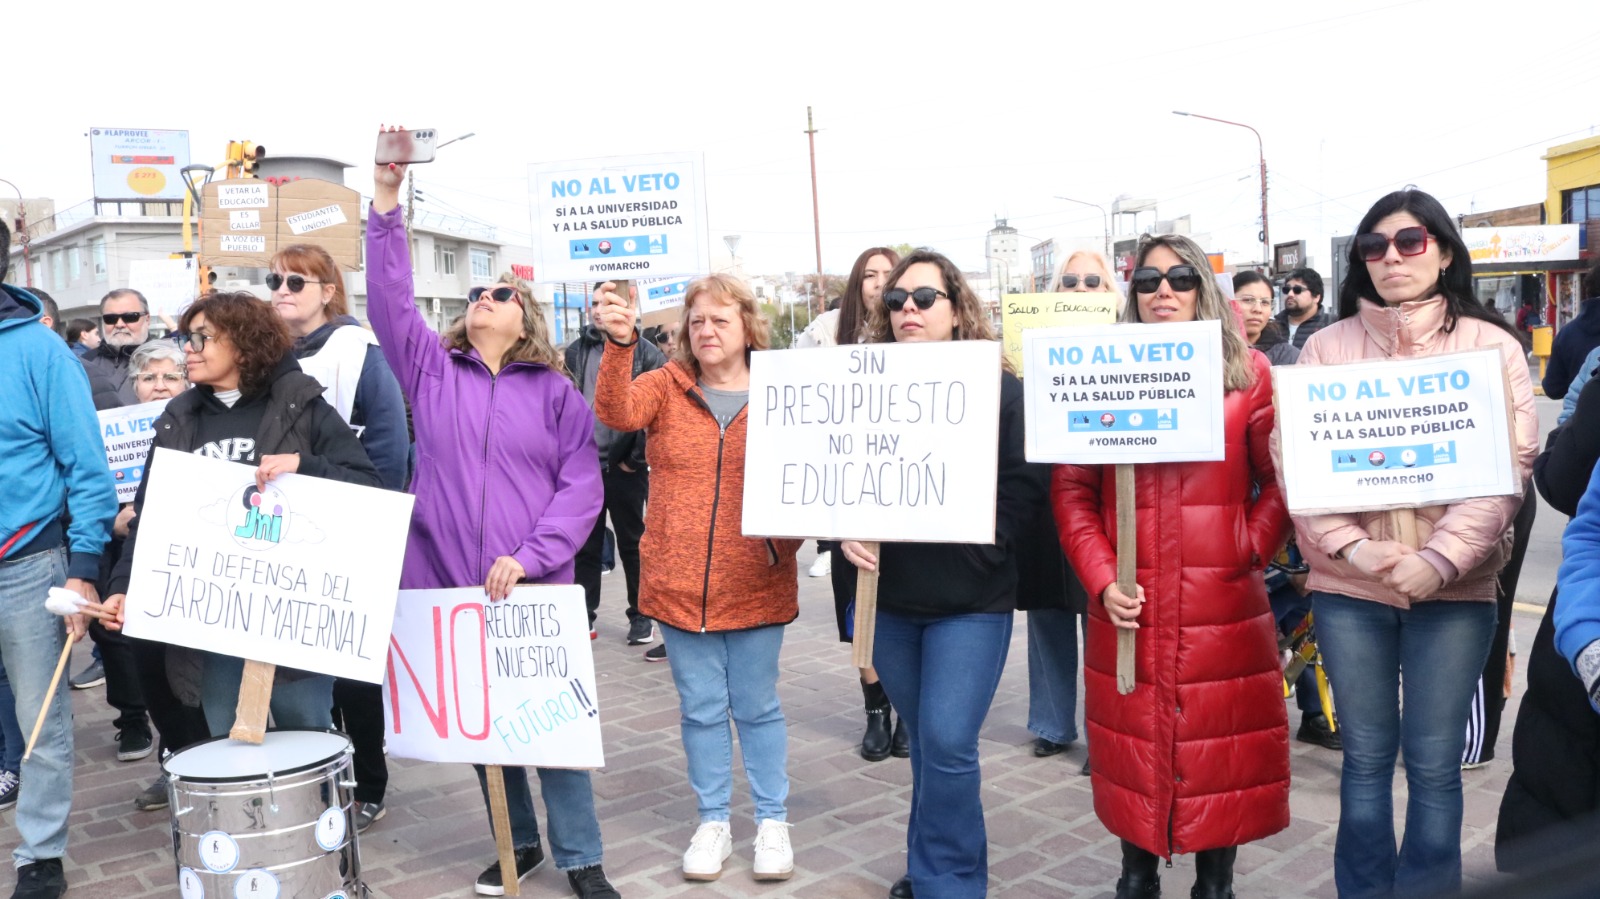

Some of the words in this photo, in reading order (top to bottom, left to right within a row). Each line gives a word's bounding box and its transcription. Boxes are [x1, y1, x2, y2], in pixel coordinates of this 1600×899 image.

[552, 179, 582, 198] NO
[589, 176, 616, 195] AL
[622, 172, 680, 193] VETO
[220, 197, 265, 205] EDUCACIÓN
[556, 205, 566, 217] SÍ
[570, 207, 577, 216] A
[580, 206, 594, 215] LA
[598, 200, 678, 214] UNIVERSIDAD
[288, 205, 339, 224] ESTUDIANTES
[553, 223, 560, 232] Y
[563, 222, 570, 232] A
[573, 222, 587, 231] LA
[590, 218, 629, 230] SALUD
[632, 215, 682, 227] PÚBLICA
[589, 261, 650, 272] #YOMARCHO
[1008, 303, 1039, 314] SALUD
[1054, 302, 1111, 315] EDUCACION
[1048, 346, 1083, 366] NO
[1091, 345, 1122, 364] AL
[1130, 342, 1194, 362] VETO
[1053, 374, 1065, 386] SÍ
[1069, 376, 1077, 385] A
[1081, 375, 1096, 385] LA
[1101, 372, 1191, 384] UNIVERSIDAD
[1308, 382, 1347, 402] NO
[1356, 379, 1390, 400] AL
[1397, 369, 1470, 396] VETO
[766, 380, 965, 426] PRESUPUESTO
[1050, 393, 1057, 402] Y
[1061, 393, 1069, 402] A
[1073, 392, 1088, 401] LA
[1092, 391, 1135, 401] SALUD
[1139, 387, 1195, 400] PÚBLICA
[1313, 410, 1327, 423] SÍ
[1332, 412, 1341, 423] A
[1345, 411, 1363, 422] LA
[1367, 401, 1469, 420] UNIVERSIDAD
[105, 422, 124, 438] AL
[1310, 431, 1319, 441] Y
[1323, 430, 1332, 440] A
[1337, 429, 1354, 440] LA
[1358, 425, 1406, 439] SALUD
[1411, 418, 1476, 435] PÚBLICA
[112, 438, 154, 452] UNIVERSID
[829, 433, 853, 455] NO
[866, 433, 900, 456] HAY
[1089, 437, 1157, 446] #YOMARCHO
[108, 452, 134, 464] SALUD
[1357, 472, 1434, 486] #YOMARCHO
[167, 543, 198, 569] EN
[212, 552, 307, 593] DEFENSA
[322, 572, 352, 603] DEL
[144, 569, 252, 632] JARDÍN
[260, 594, 371, 660] MATERNAL
[387, 602, 490, 740] NO
[485, 603, 560, 639] RECORTES
[495, 646, 568, 678] NUESTRO
